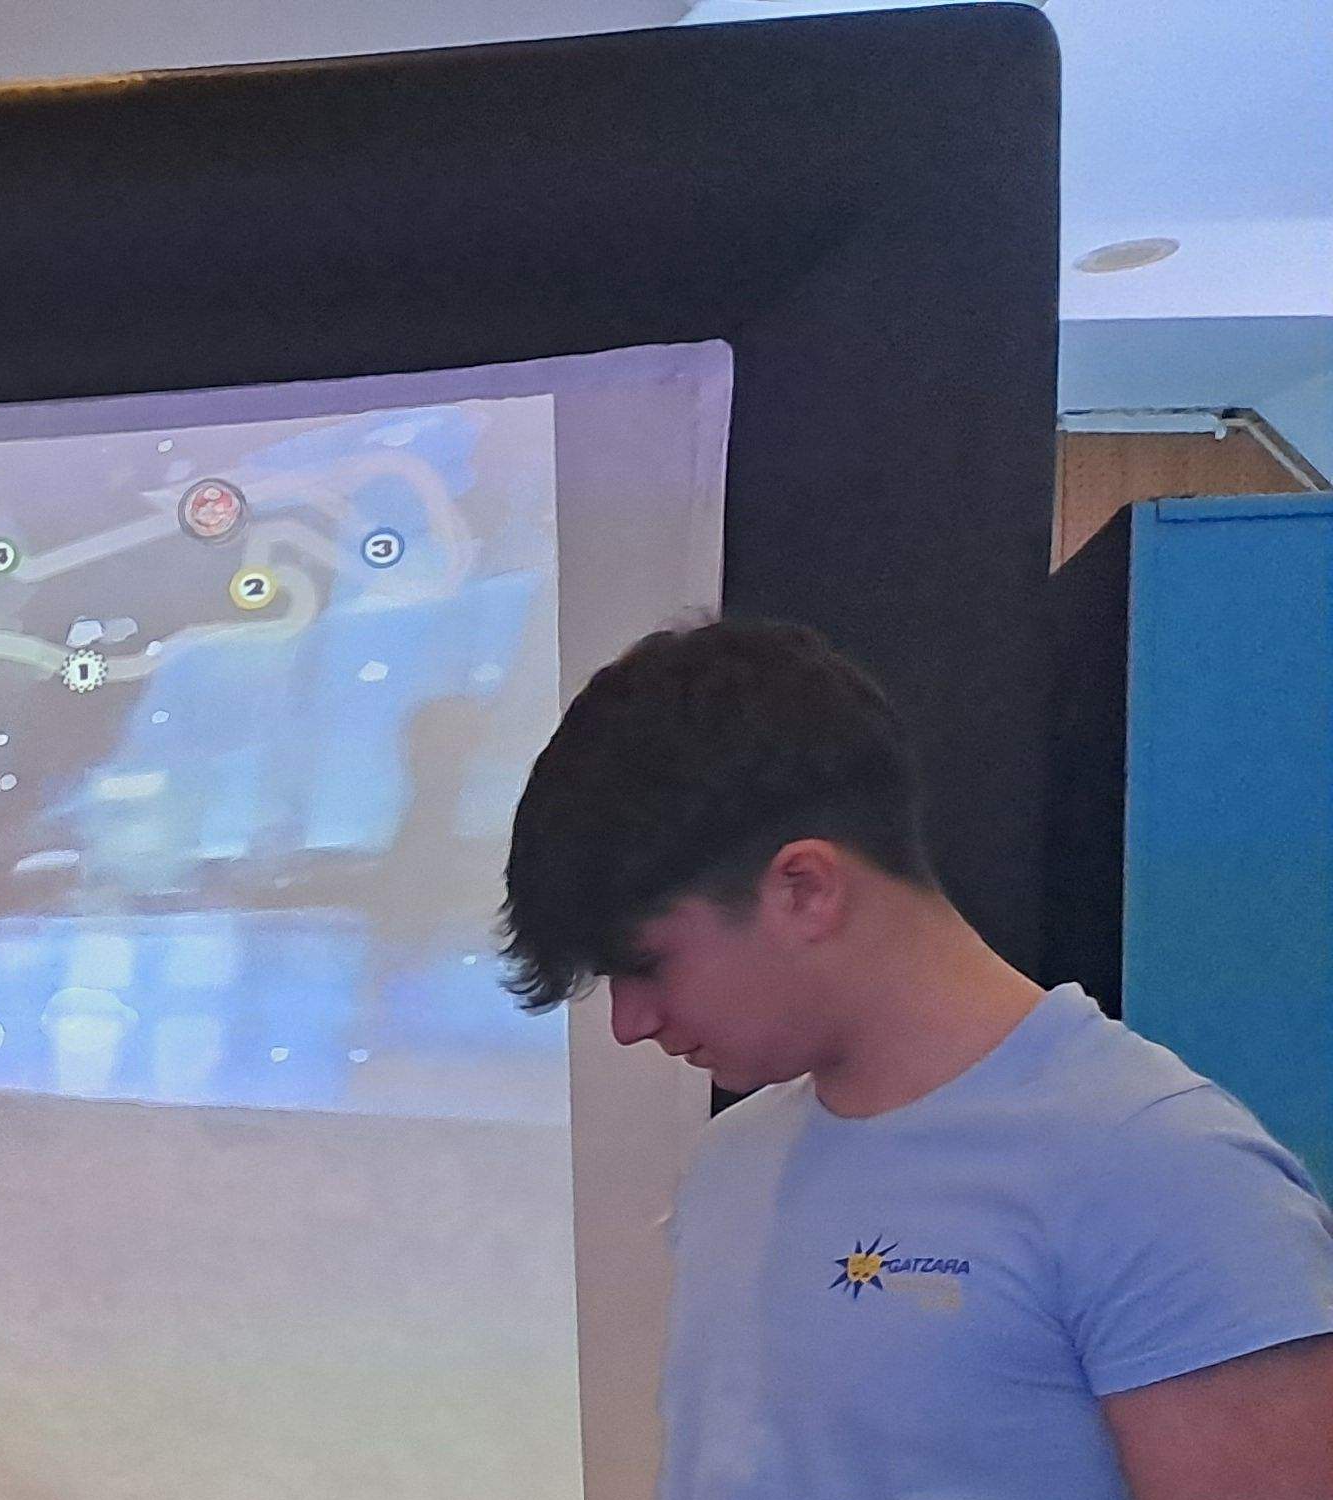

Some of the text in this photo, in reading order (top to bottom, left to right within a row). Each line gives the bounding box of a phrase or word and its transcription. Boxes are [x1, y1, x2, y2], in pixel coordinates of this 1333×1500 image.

[371, 539, 393, 558] 3
[243, 578, 265, 596] 2
[78, 663, 89, 680] 1
[888, 1257, 970, 1274] GATZARA
